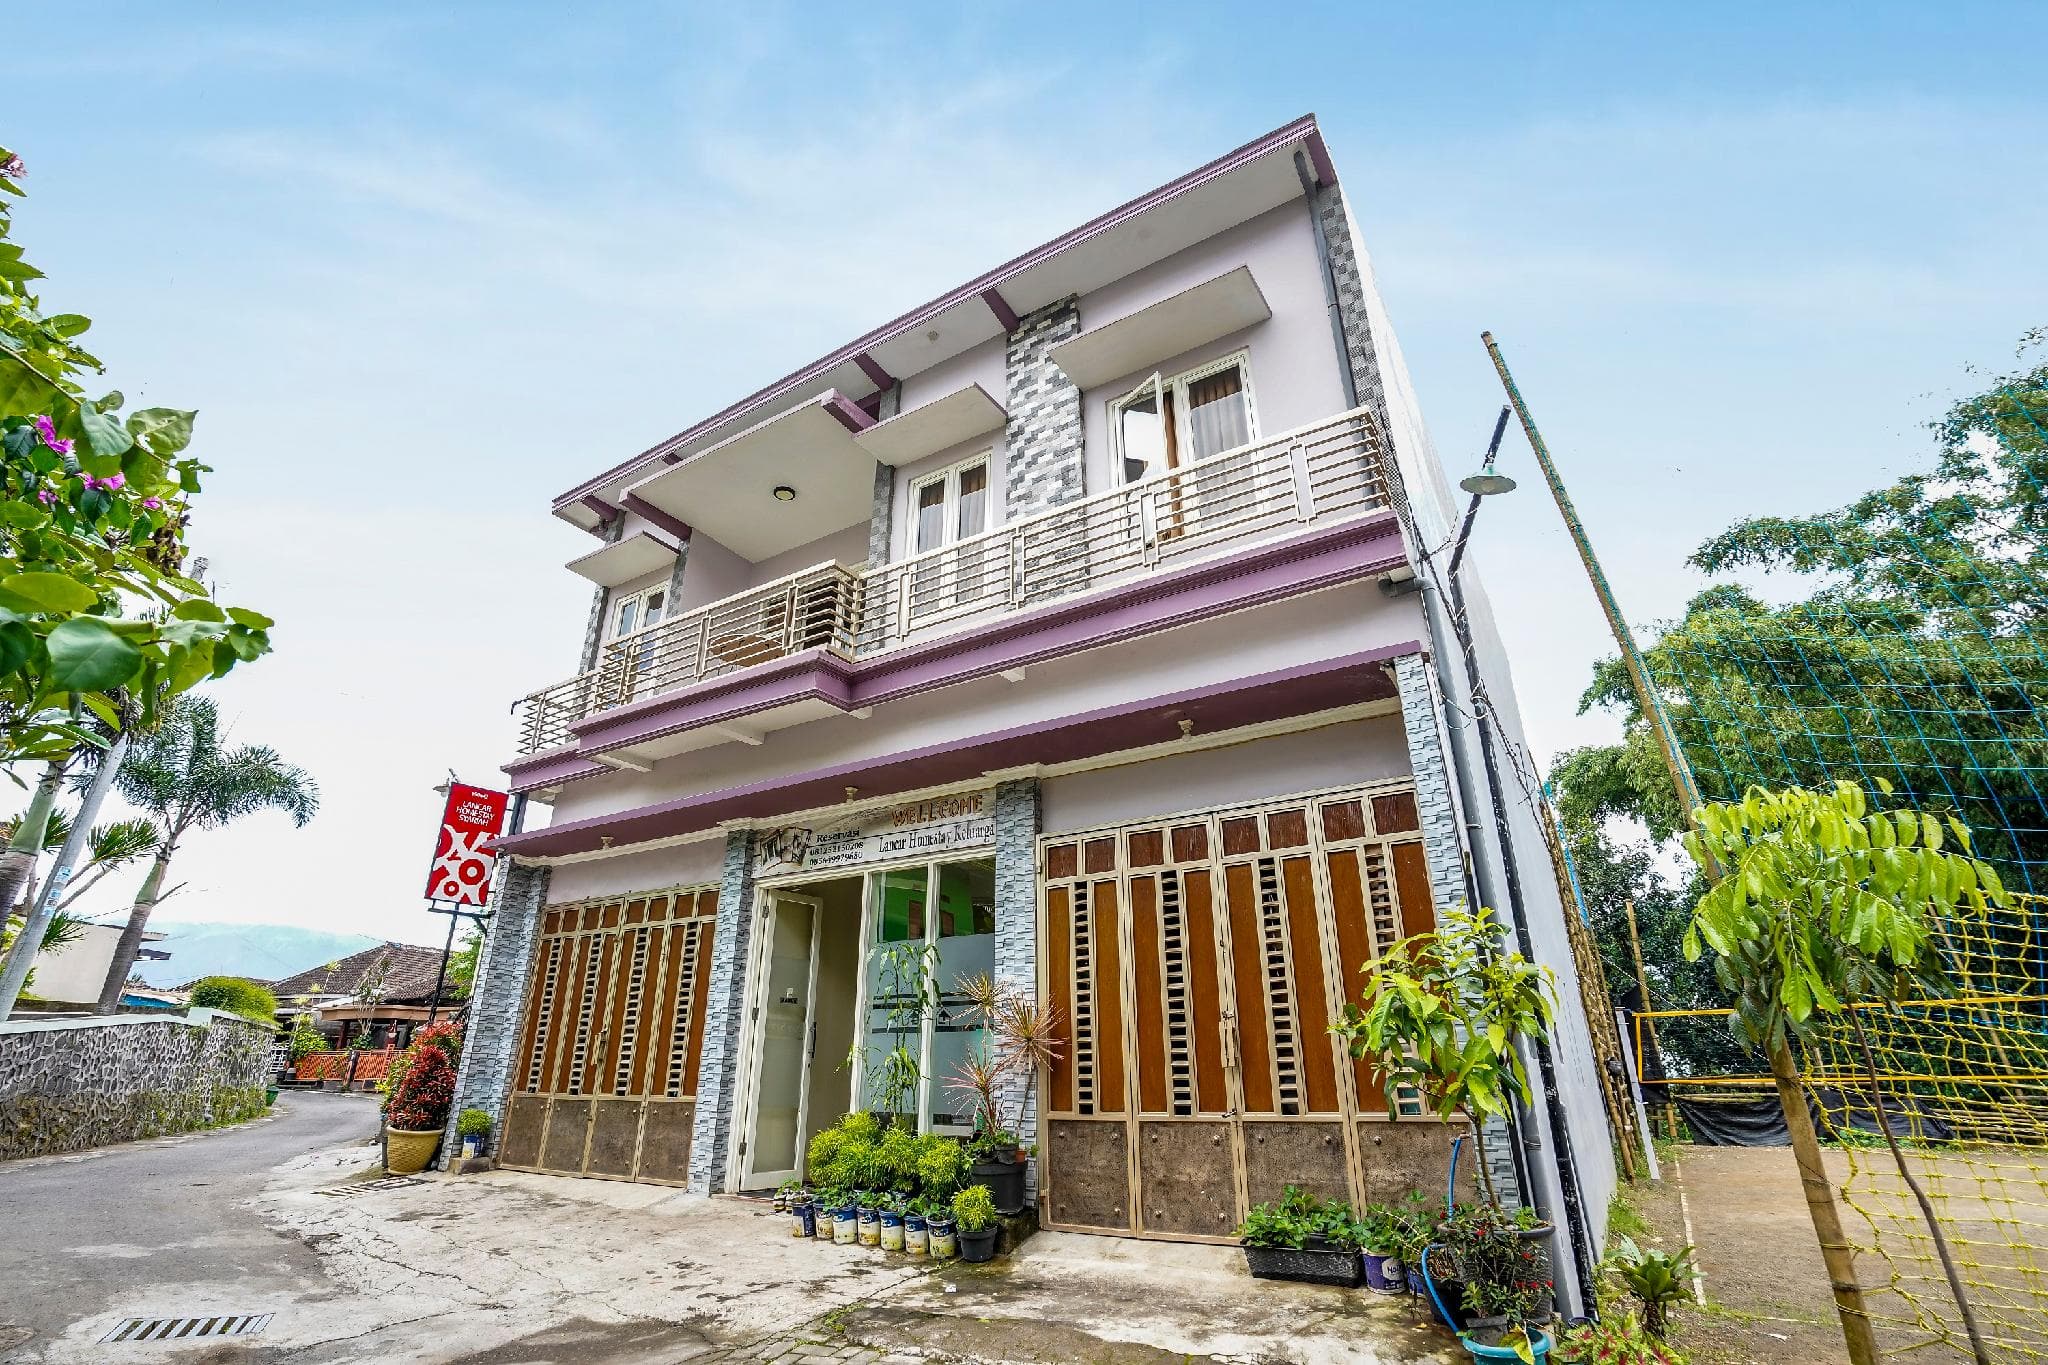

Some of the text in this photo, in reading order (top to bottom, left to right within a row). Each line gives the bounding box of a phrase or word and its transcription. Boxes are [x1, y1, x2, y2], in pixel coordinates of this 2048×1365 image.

[456, 806, 495, 820] HOMESTAY
[463, 801, 492, 812] LANCAR
[892, 795, 983, 826] WELLCOME
[816, 826, 860, 843] Reservasi
[878, 821, 995, 853] Lancar Homestay Keluarga
